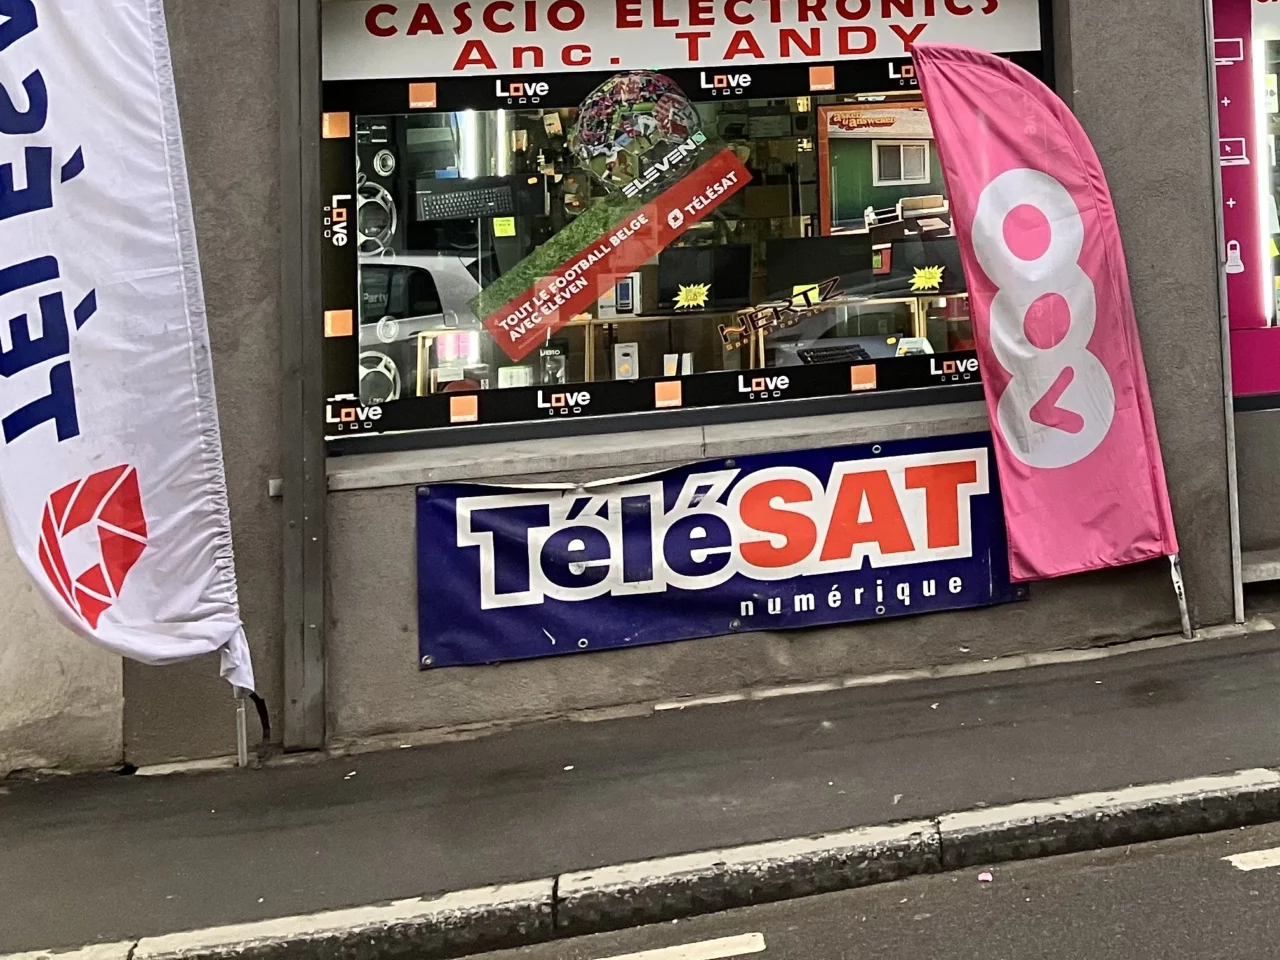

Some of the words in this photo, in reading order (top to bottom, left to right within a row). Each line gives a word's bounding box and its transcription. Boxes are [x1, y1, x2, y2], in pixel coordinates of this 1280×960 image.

[452, 39, 620, 71] Anc.
[675, 22, 928, 62] TANDY
[495, 79, 549, 97] Love
[700, 71, 752, 90] Love
[889, 62, 915, 79] Lo
[622, 136, 701, 198] ELEVEN
[683, 170, 739, 216] TÉLÉSAT
[331, 194, 352, 247] Love
[498, 301, 534, 332] TOUT
[548, 242, 612, 294] FOOTBALL
[610, 213, 650, 248] BELGE
[509, 312, 544, 343] AVEC
[541, 277, 589, 320] ELEVEN
[718, 276, 845, 344] HERTZ
[738, 374, 790, 393] Love
[930, 357, 979, 375] Love
[325, 404, 383, 424] Love
[537, 390, 591, 408] Love
[466, 456, 981, 601] TéléSAT
[740, 575, 962, 617] numérique
